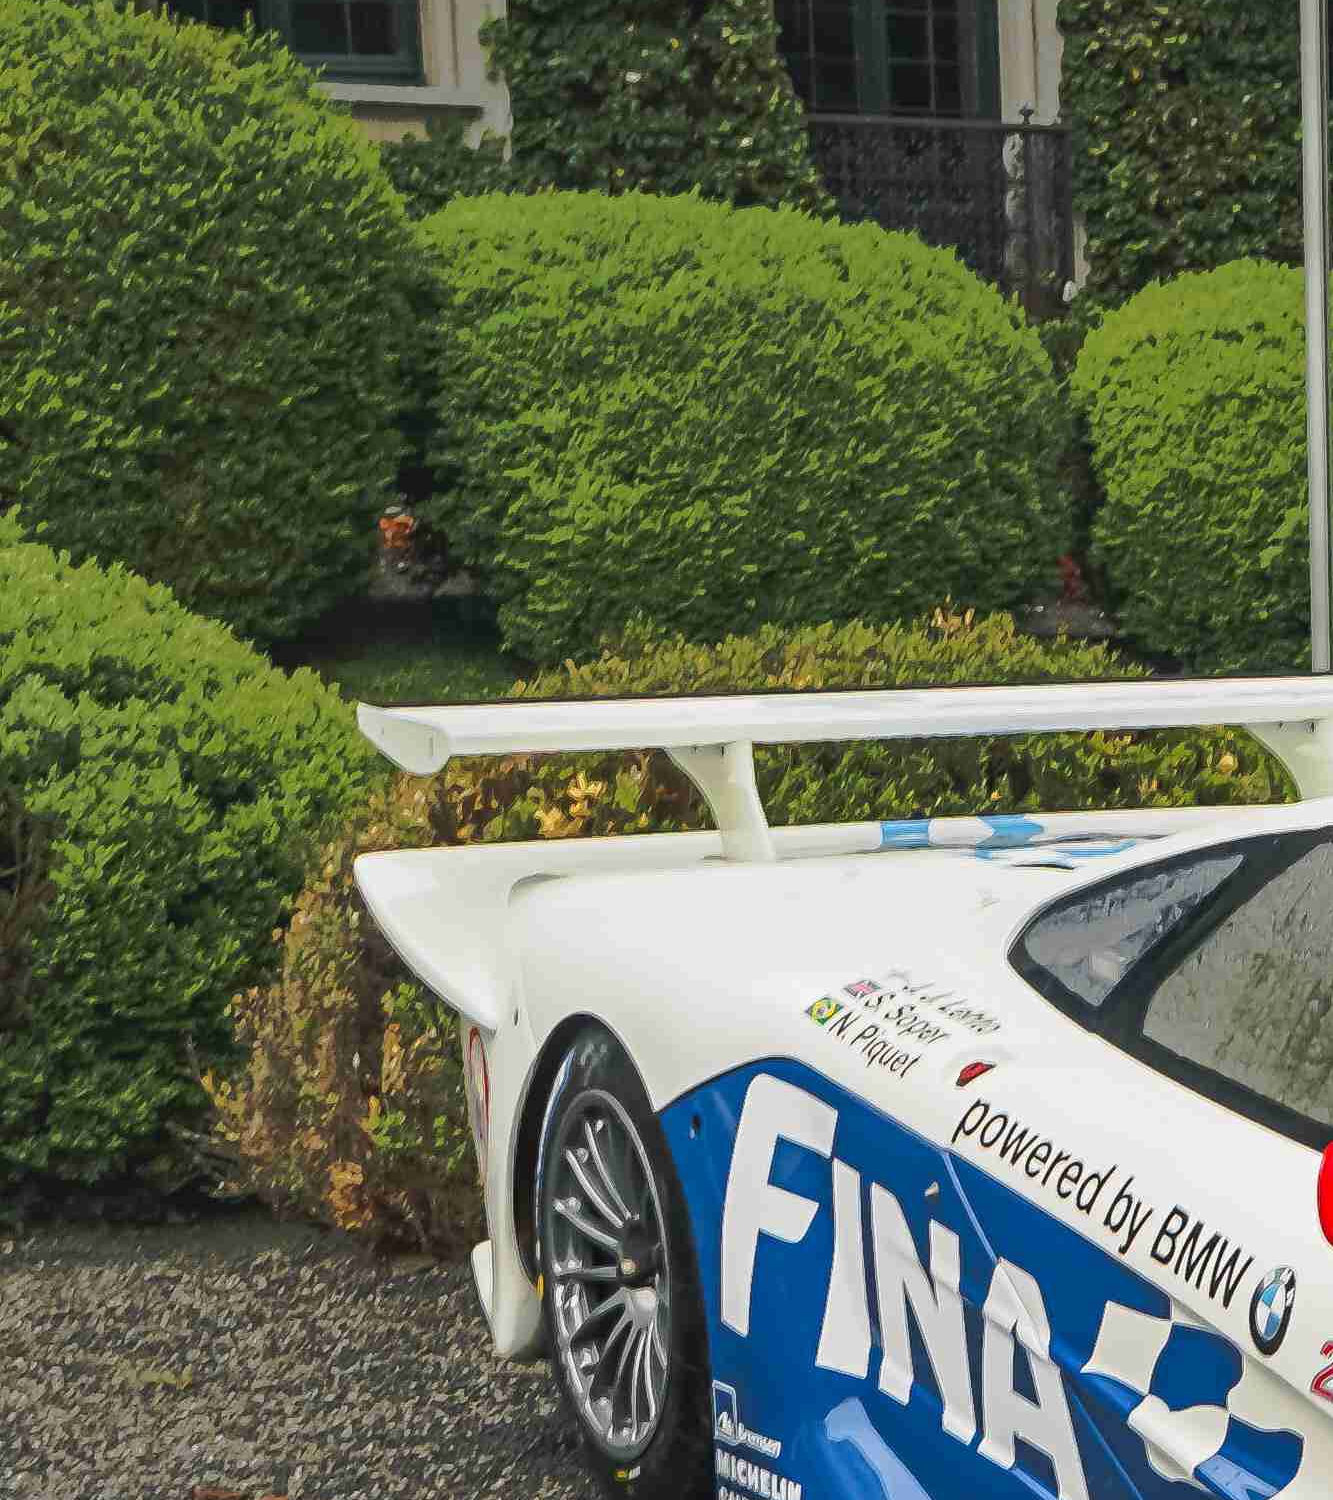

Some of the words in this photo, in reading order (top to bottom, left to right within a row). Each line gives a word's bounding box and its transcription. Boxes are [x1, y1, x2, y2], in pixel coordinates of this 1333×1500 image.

[850, 1024, 923, 1078] Piquet
[951, 1098, 1118, 1215] powered
[1103, 1176, 1153, 1254] by
[1150, 1204, 1254, 1309] BMW
